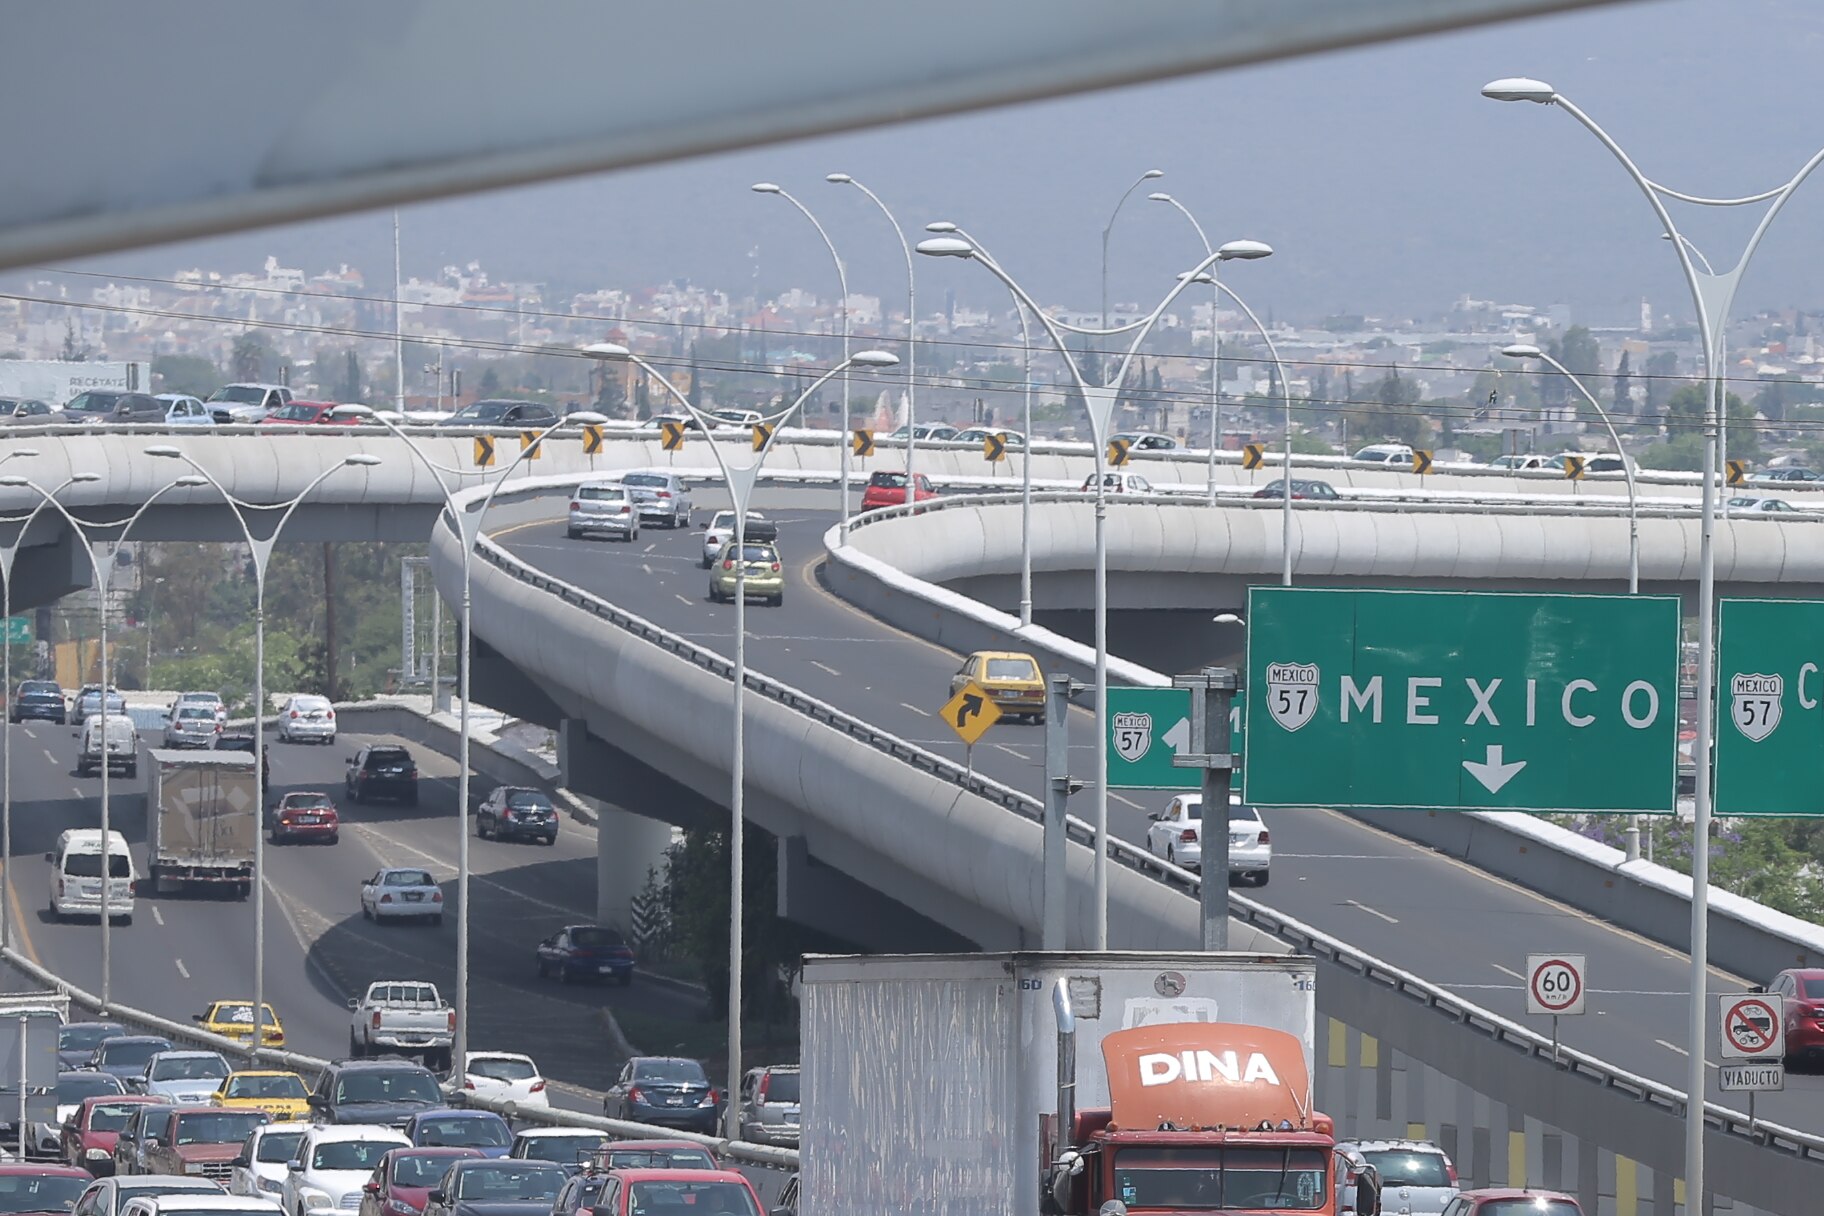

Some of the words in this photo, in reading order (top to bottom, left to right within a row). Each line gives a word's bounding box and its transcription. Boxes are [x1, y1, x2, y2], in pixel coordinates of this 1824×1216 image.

[1272, 669, 1314, 682] MEXICO
[1737, 679, 1776, 693] MEXICO
[1278, 690, 1308, 715] 57
[1340, 675, 1659, 729] MEXICO
[1117, 717, 1148, 727] MEXICO
[1743, 701, 1771, 726] 57
[1121, 732, 1142, 750] 57
[1543, 971, 1570, 992] 60
[1139, 1050, 1280, 1086] DINA
[1724, 1071, 1779, 1085] VIADUCTO
